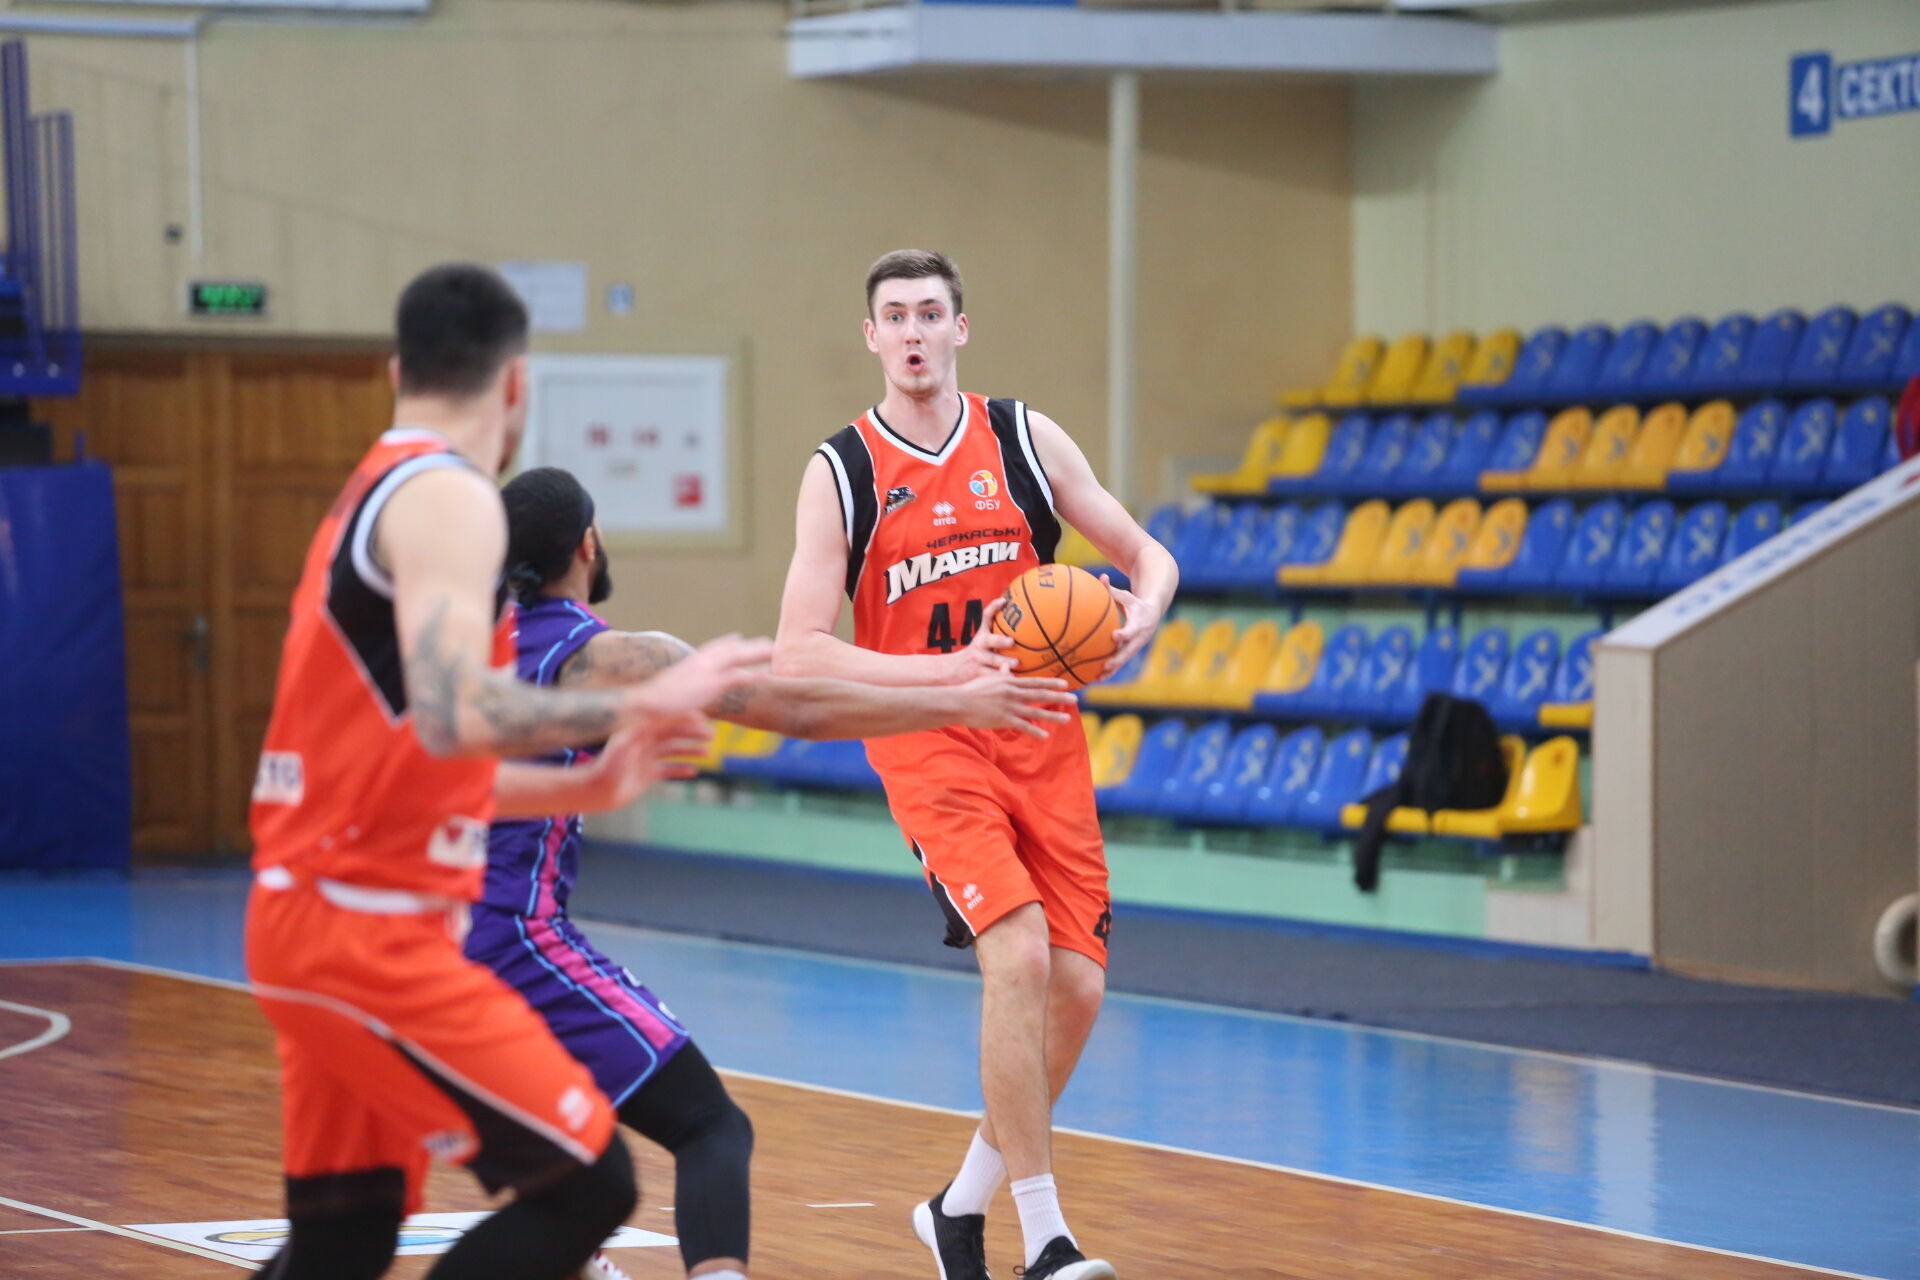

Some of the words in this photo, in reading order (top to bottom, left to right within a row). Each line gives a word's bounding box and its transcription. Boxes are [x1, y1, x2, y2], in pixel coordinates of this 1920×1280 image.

[1798, 62, 1823, 125] 4
[975, 499, 1001, 511] ФБУ
[926, 527, 1022, 549] ЧЕРКАСЬКІ
[885, 541, 1022, 606] МАВПИ
